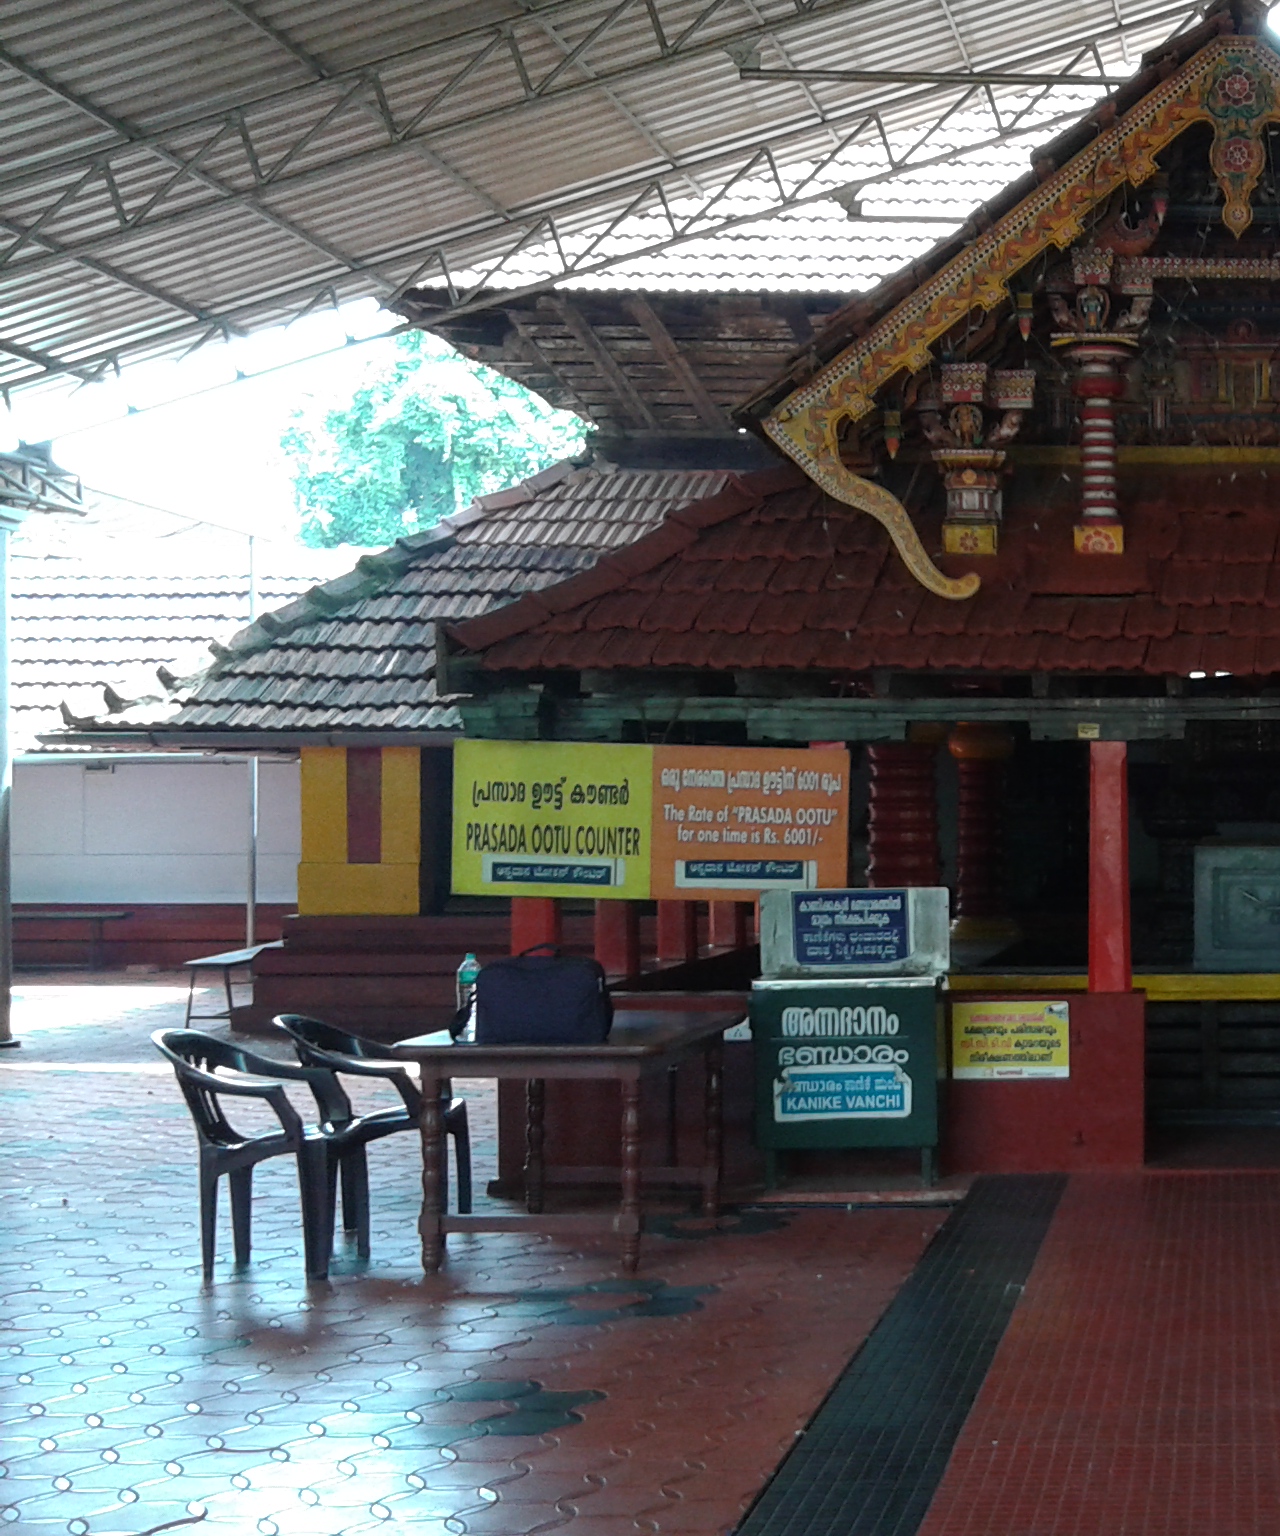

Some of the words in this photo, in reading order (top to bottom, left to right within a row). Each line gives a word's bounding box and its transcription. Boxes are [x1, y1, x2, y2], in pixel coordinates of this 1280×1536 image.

[797, 771, 819, 790] 6001
[472, 781, 526, 807] പ്രസാദ
[532, 776, 566, 810] ഊട്ട്
[664, 804, 684, 821] The
[688, 805, 712, 822] Rate
[717, 806, 728, 822] of
[466, 822, 526, 852] PRASADA
[532, 824, 570, 853] OOTU
[576, 826, 640, 855] COUNTER
[678, 824, 693, 841] for
[697, 829, 718, 842] one
[723, 826, 747, 843] time
[751, 827, 760, 843] is
[764, 828, 780, 843] Rs.
[784, 828, 823, 846] 6001/-
[782, 1007, 899, 1036] അന്നദാനം
[778, 1045, 909, 1065] ഭണ്ഡാരം
[786, 1096, 841, 1111] KANIKE
[846, 1094, 900, 1109] VANCHI
